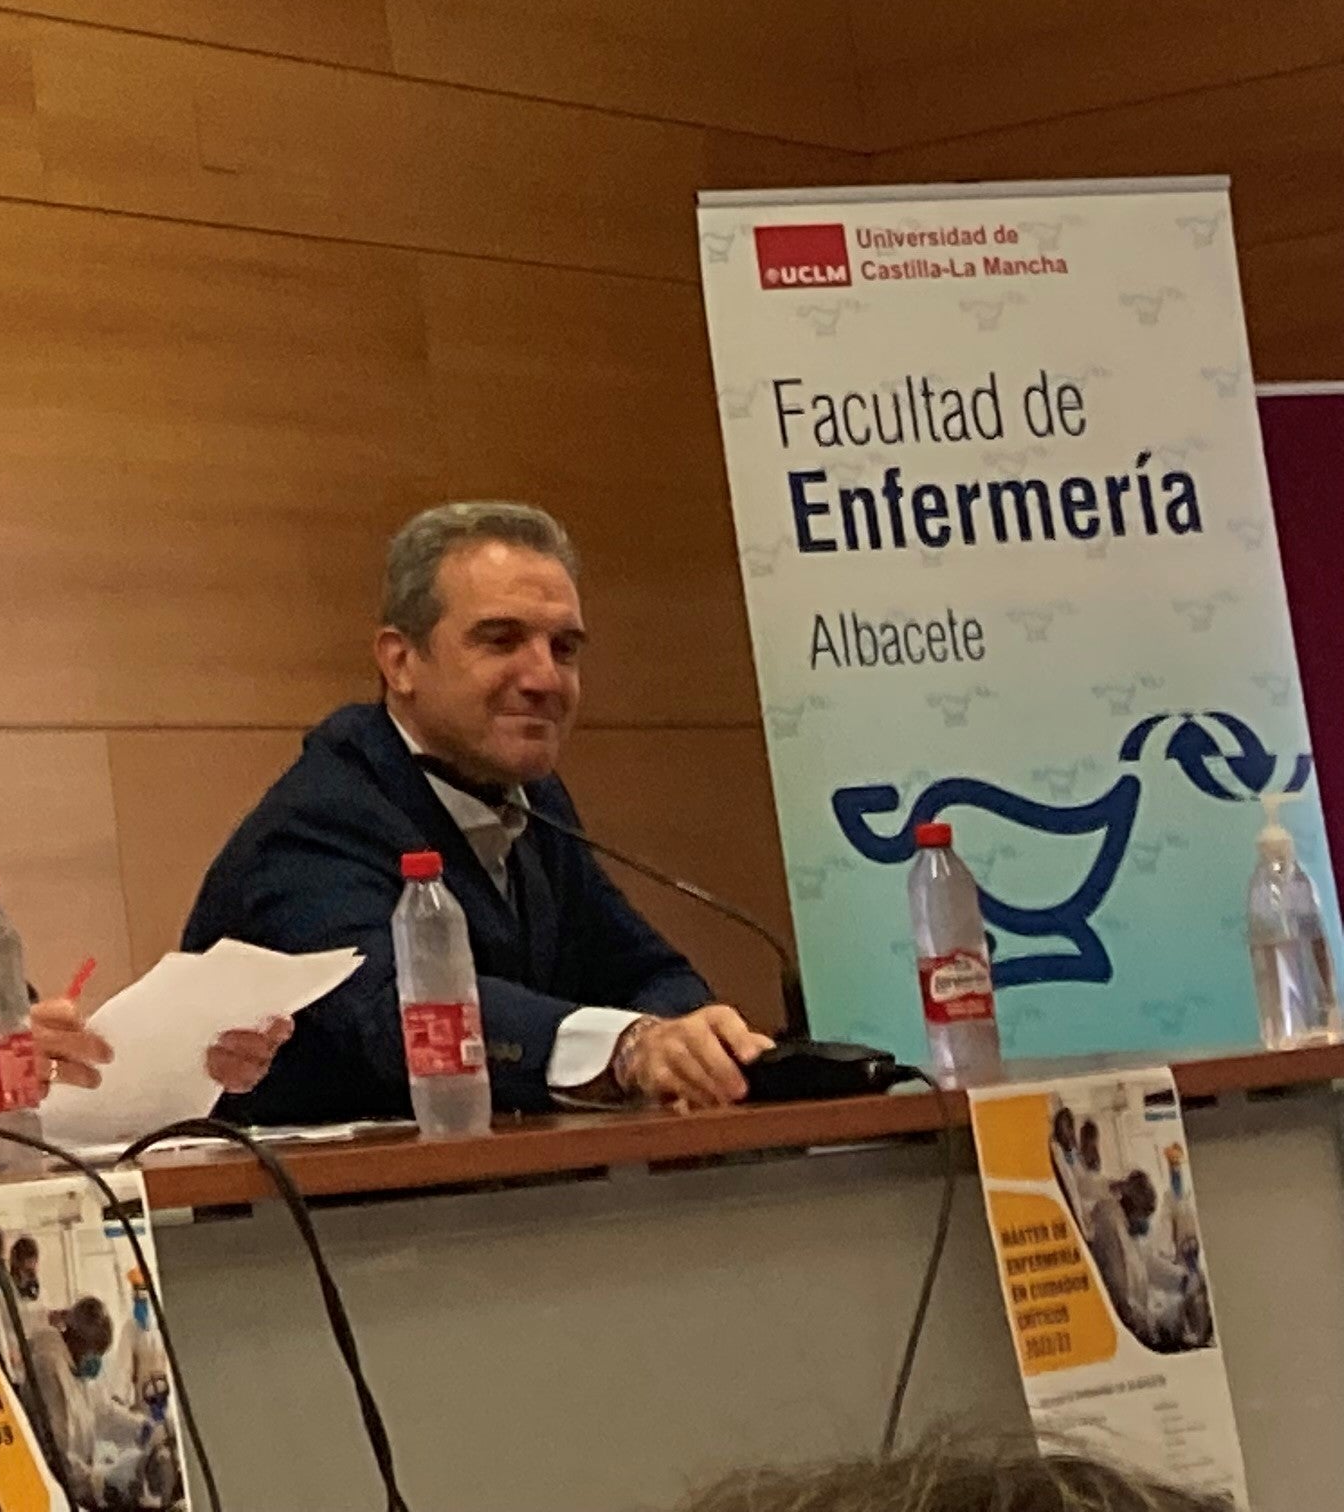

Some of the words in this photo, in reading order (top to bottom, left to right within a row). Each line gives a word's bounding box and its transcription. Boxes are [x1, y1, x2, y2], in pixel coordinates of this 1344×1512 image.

[856, 225, 986, 248] Universidad
[994, 225, 1019, 244] de
[781, 266, 847, 285] UCLM
[861, 258, 977, 281] Castilla-La
[983, 256, 1069, 276] Mancha
[773, 372, 1004, 448] Facultad
[1024, 370, 1086, 438] de
[788, 451, 1203, 553] Enfermería
[812, 608, 986, 670] Albacete
